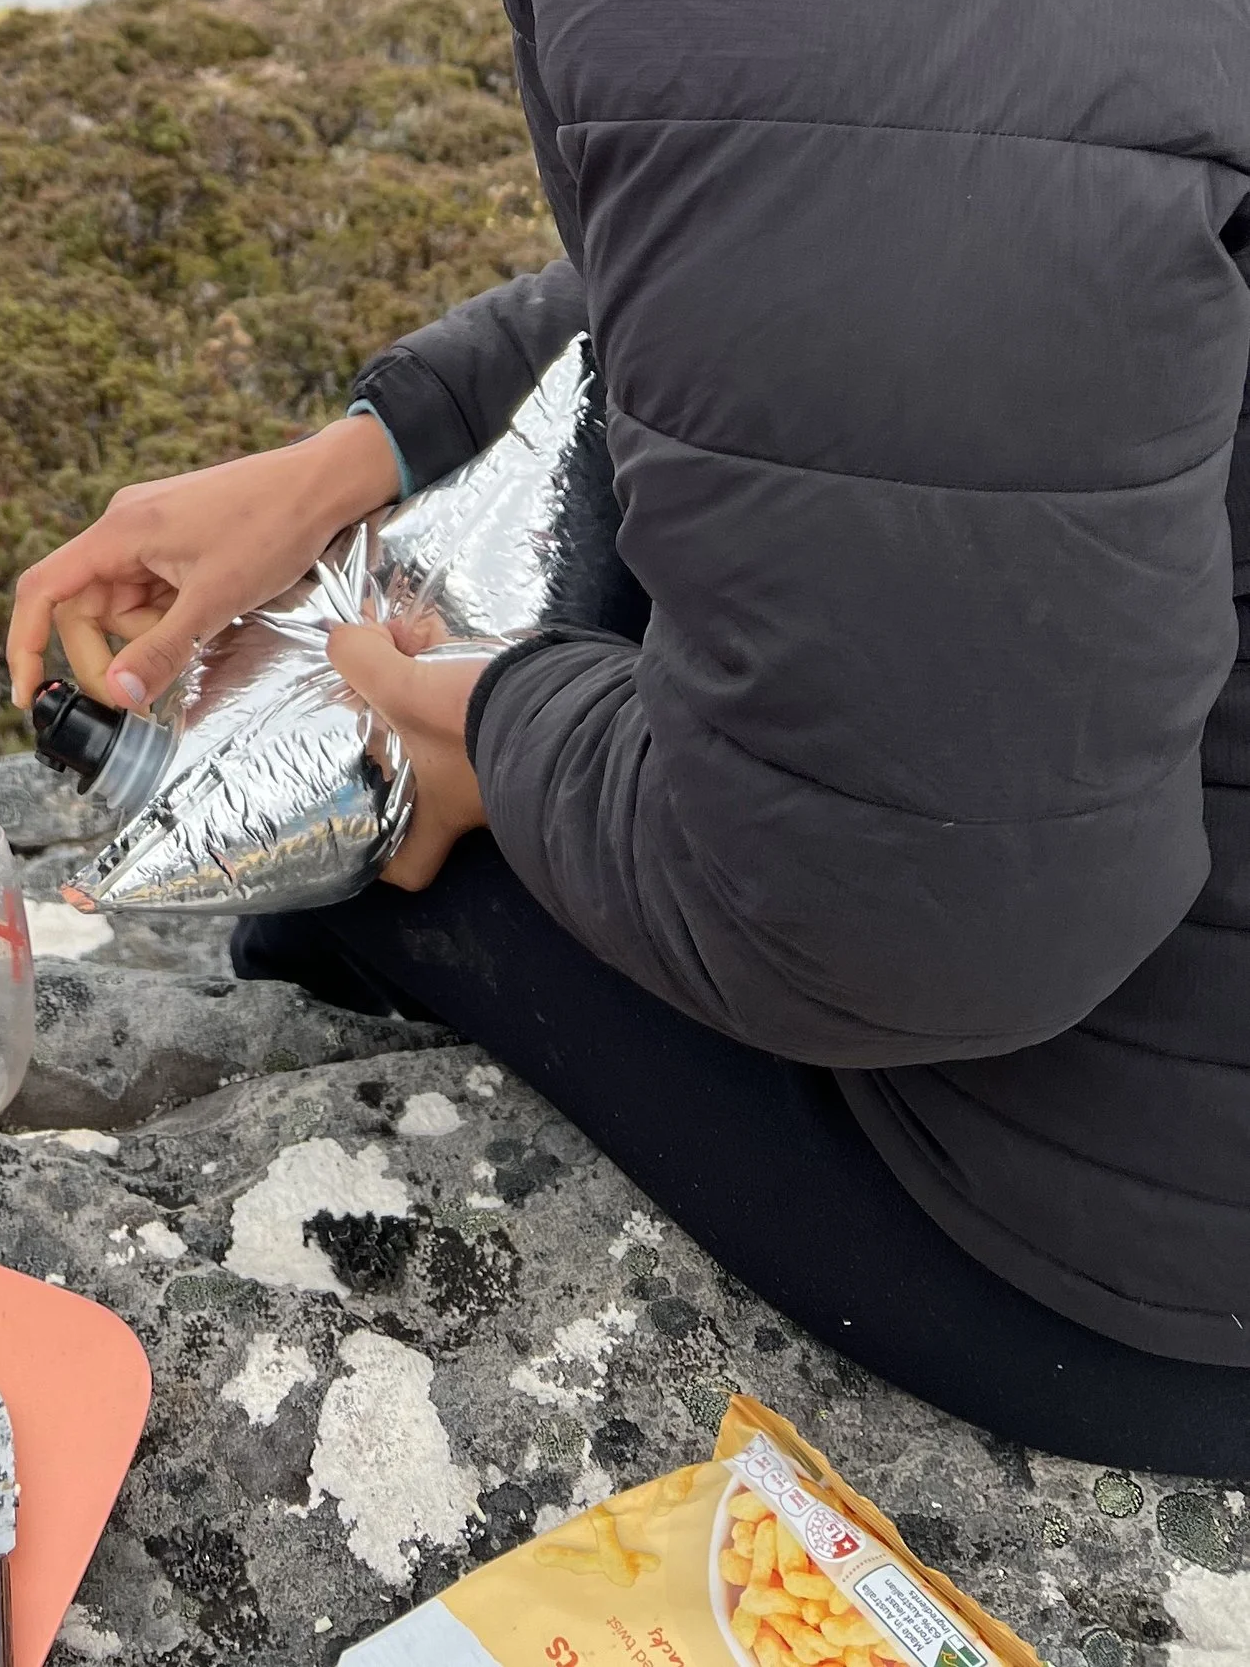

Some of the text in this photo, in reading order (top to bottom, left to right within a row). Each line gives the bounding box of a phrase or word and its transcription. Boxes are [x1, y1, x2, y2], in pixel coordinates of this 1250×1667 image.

[606, 1615, 637, 1651] twist
[861, 1584, 925, 1652] Made in Australia
[884, 1579, 942, 1639] 63% Australian
[884, 1594, 934, 1646] from at least
[647, 1627, 684, 1667] acks
